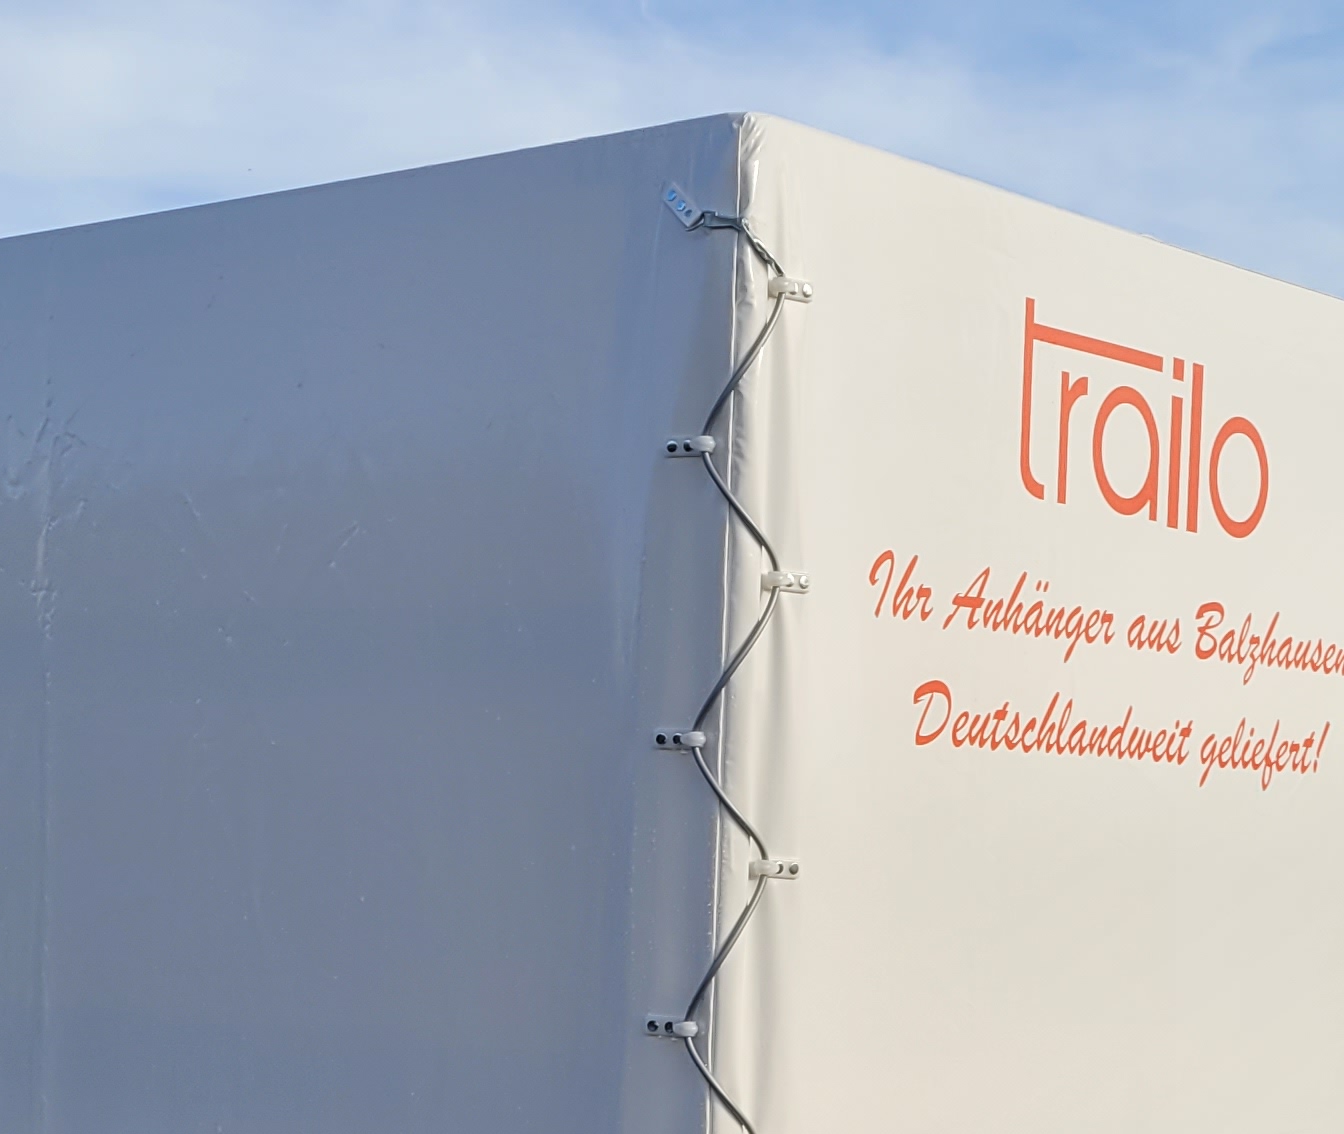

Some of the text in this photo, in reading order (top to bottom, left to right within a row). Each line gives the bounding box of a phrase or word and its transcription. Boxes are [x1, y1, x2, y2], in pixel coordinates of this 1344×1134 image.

[1019, 296, 1270, 539] trailo
[869, 549, 934, 622] Ihr
[942, 566, 1115, 663] Anhänger
[1126, 612, 1182, 654] aus
[912, 679, 1331, 792] Deutschlandweit geliefert!
